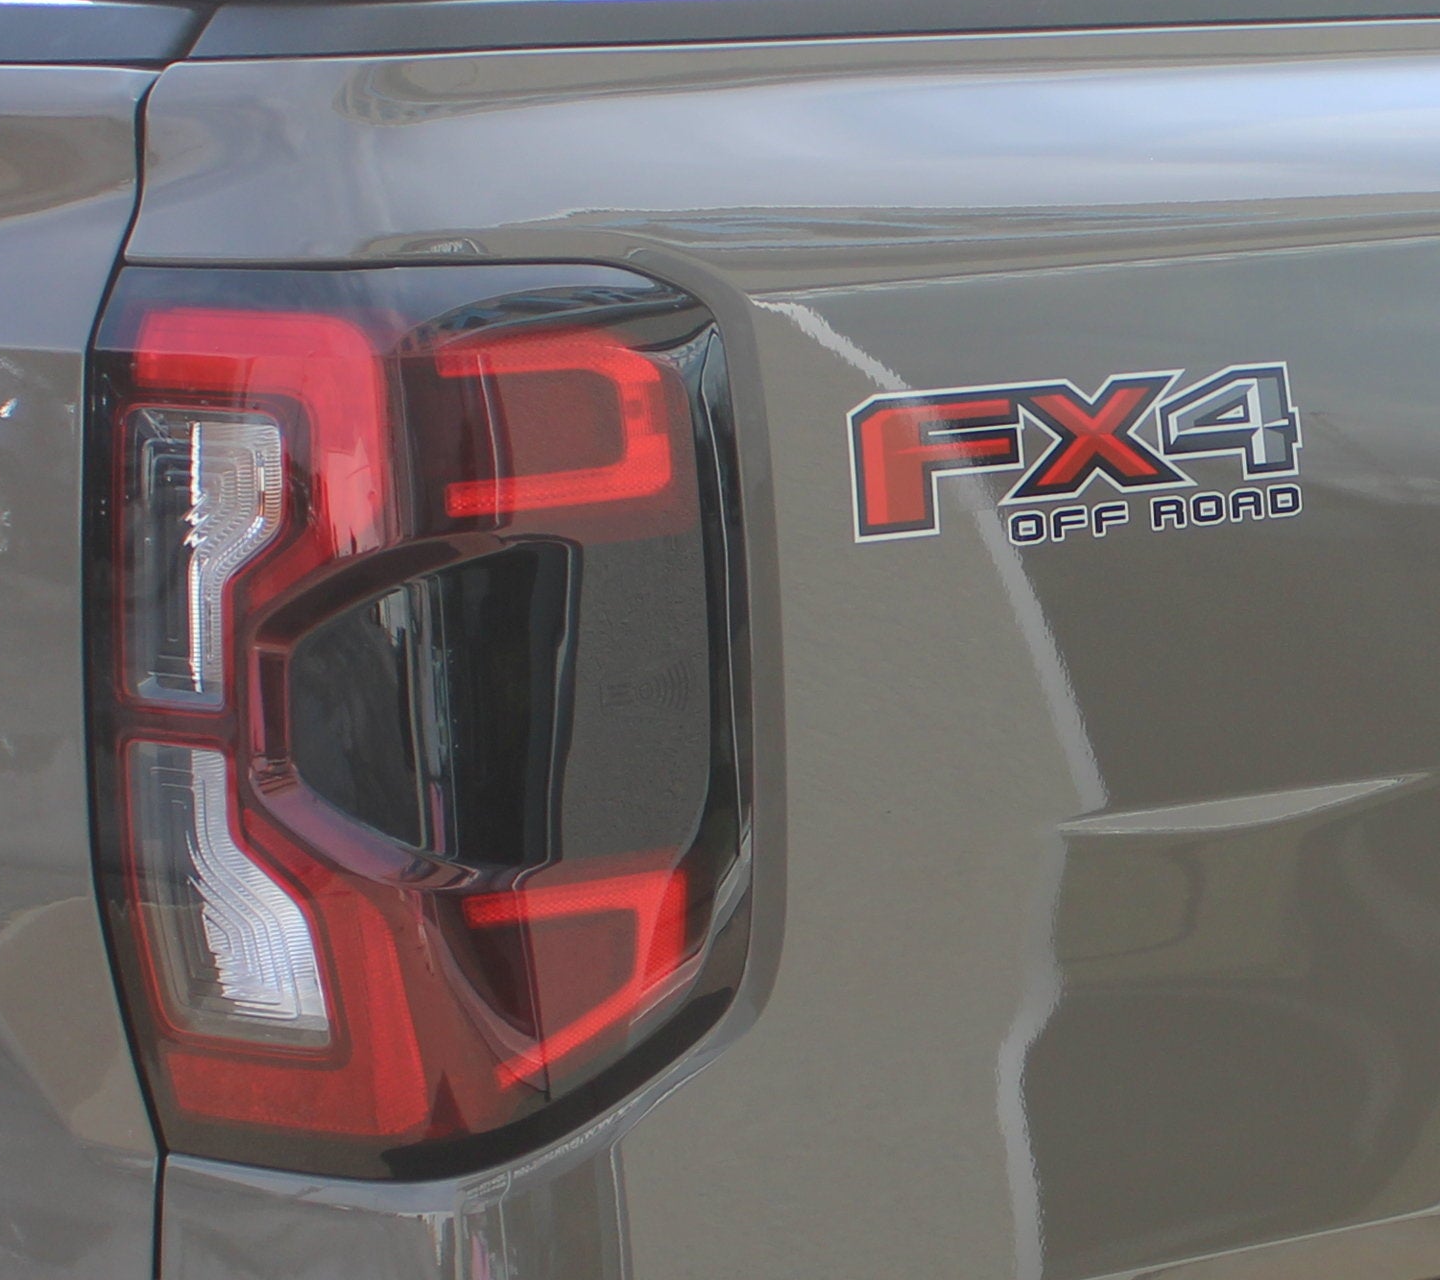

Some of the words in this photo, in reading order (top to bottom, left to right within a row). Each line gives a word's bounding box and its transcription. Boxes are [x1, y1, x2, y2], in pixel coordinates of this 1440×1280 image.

[846, 361, 1303, 543] FX4
[1008, 501, 1129, 546] OFF
[1150, 483, 1303, 532] ROAD
